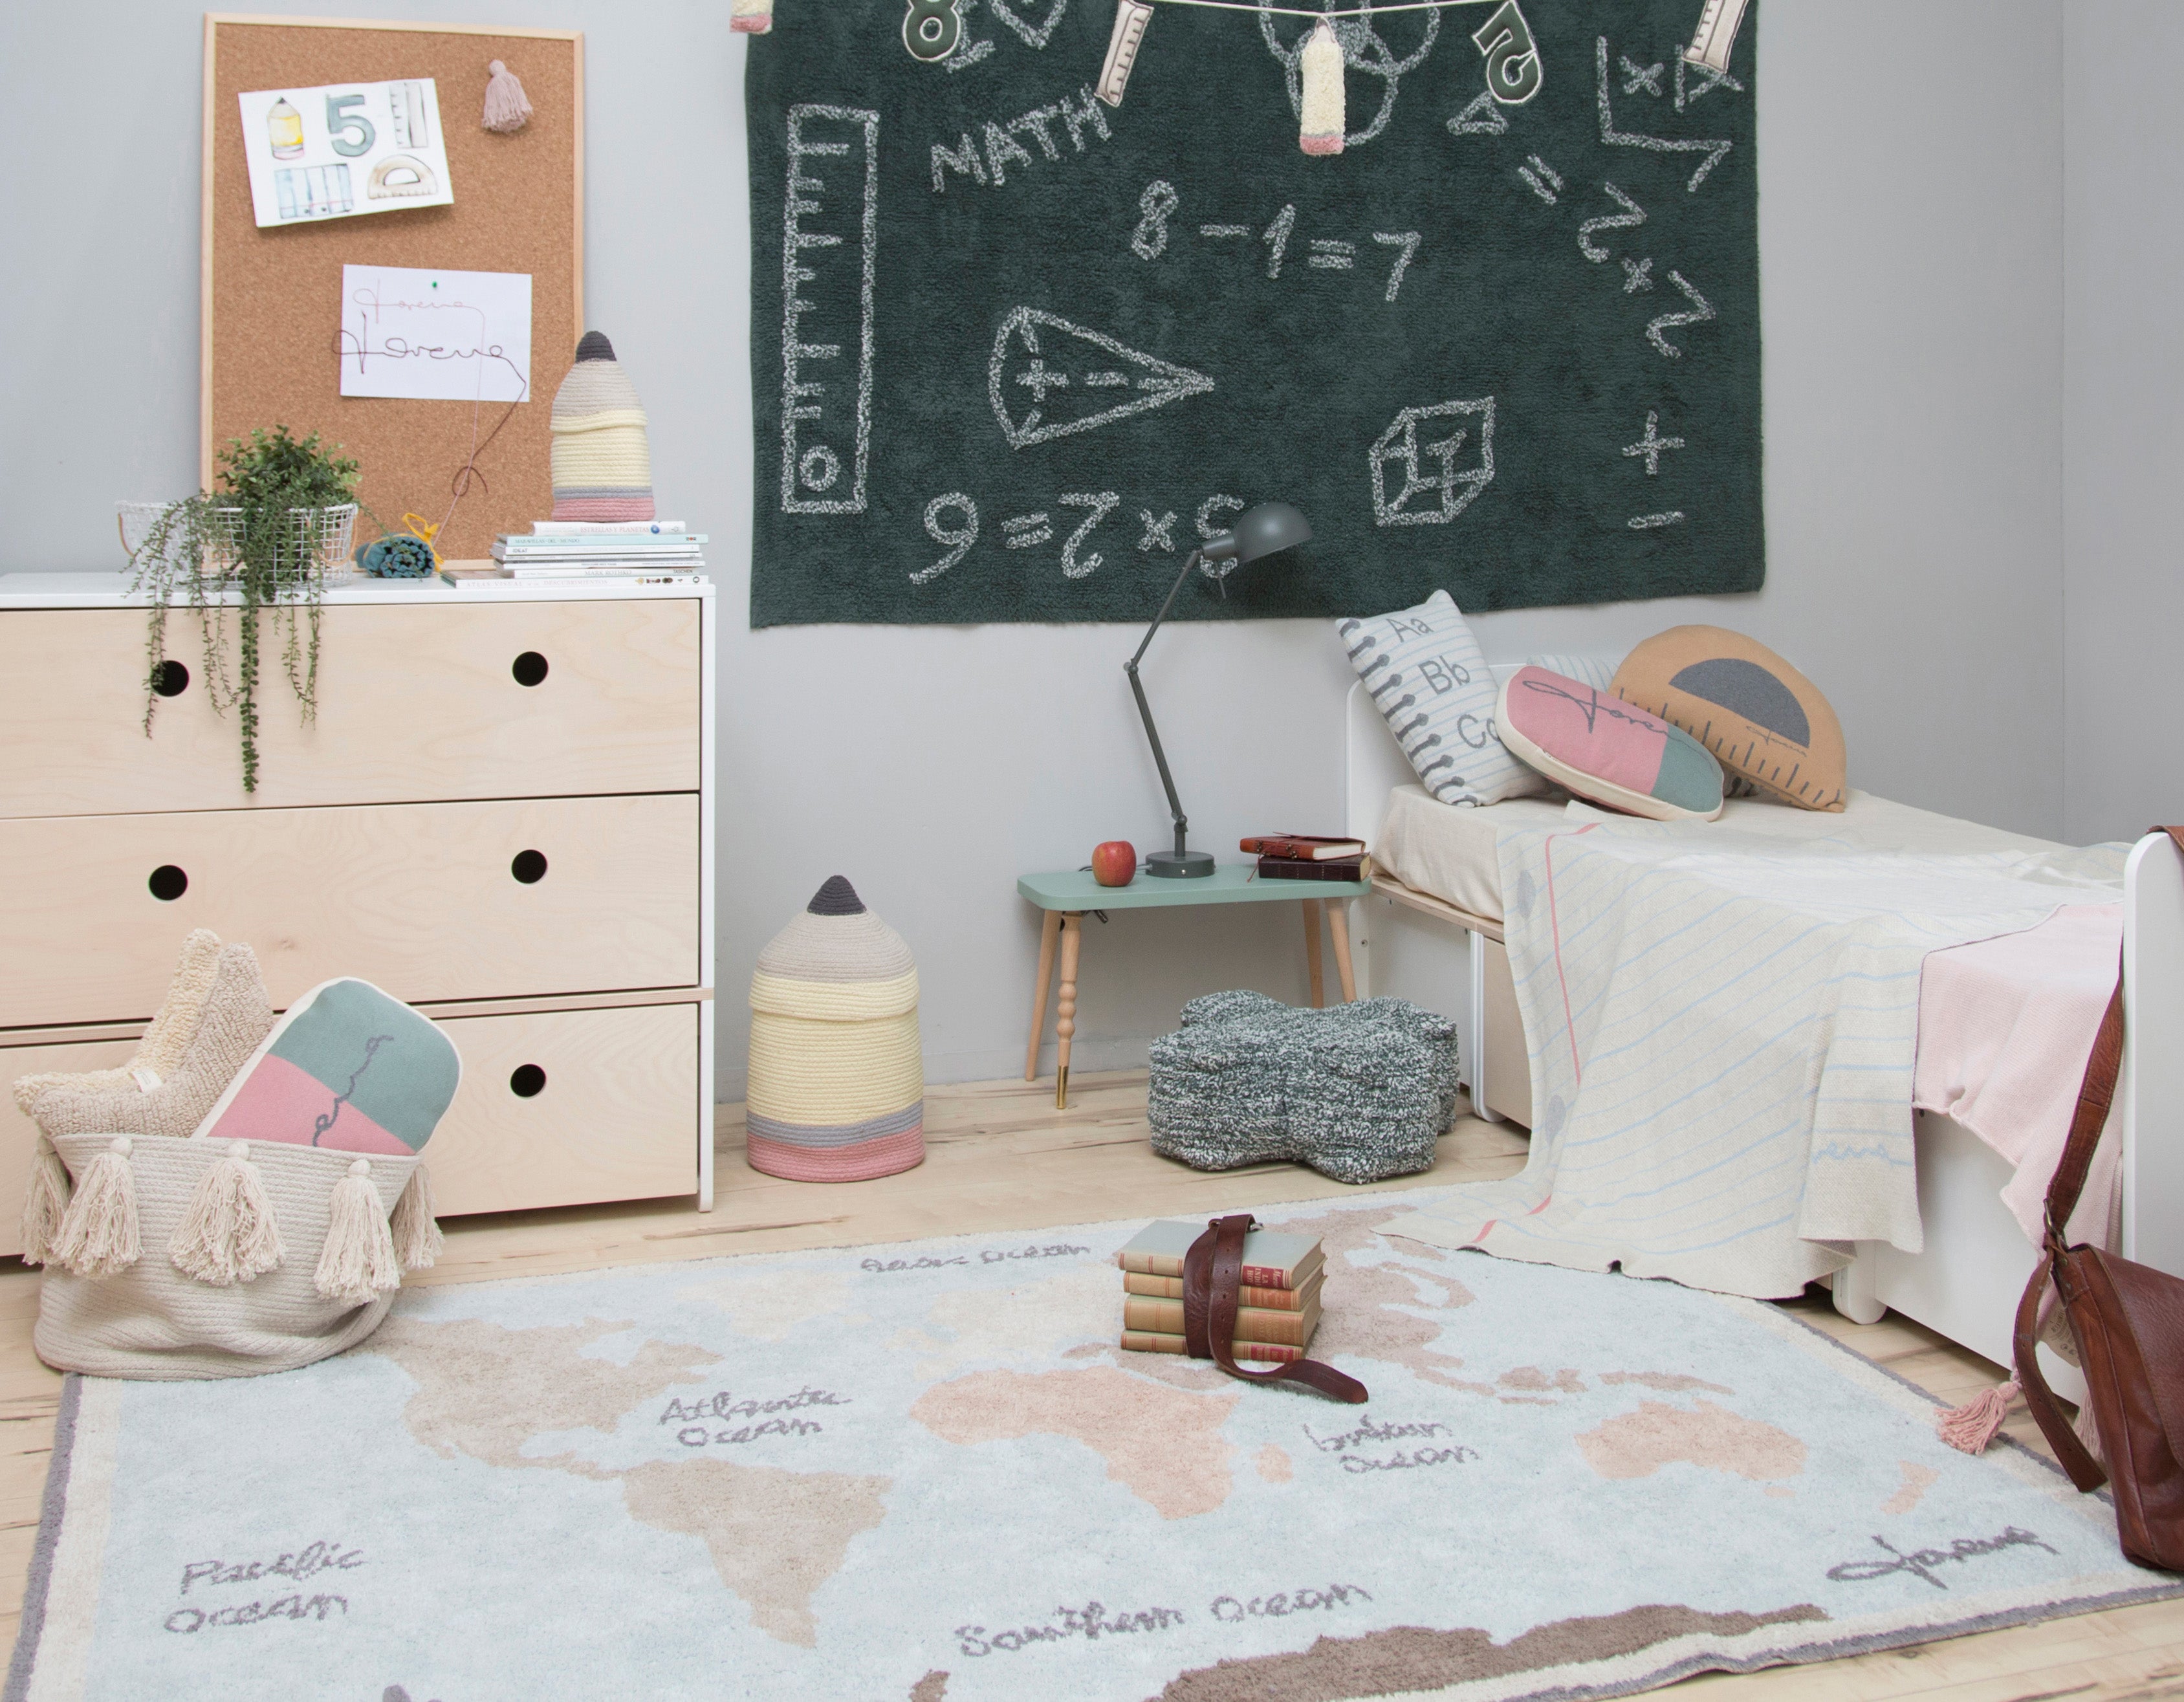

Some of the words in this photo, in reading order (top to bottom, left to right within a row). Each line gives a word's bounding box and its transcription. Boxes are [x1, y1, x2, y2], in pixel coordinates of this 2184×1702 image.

[325, 93, 376, 157] 5
[930, 83, 1112, 193] MATH
[1131, 180, 1179, 260] 8
[1263, 204, 1295, 279] 1
[1373, 231, 1421, 302] 7
[1386, 618, 1434, 643] Aa
[1418, 655, 1471, 695] Bb
[677, 1418, 822, 1447] Ocean
[164, 1593, 349, 1635] Ocean
[1210, 1583, 1374, 1622] Ocean
